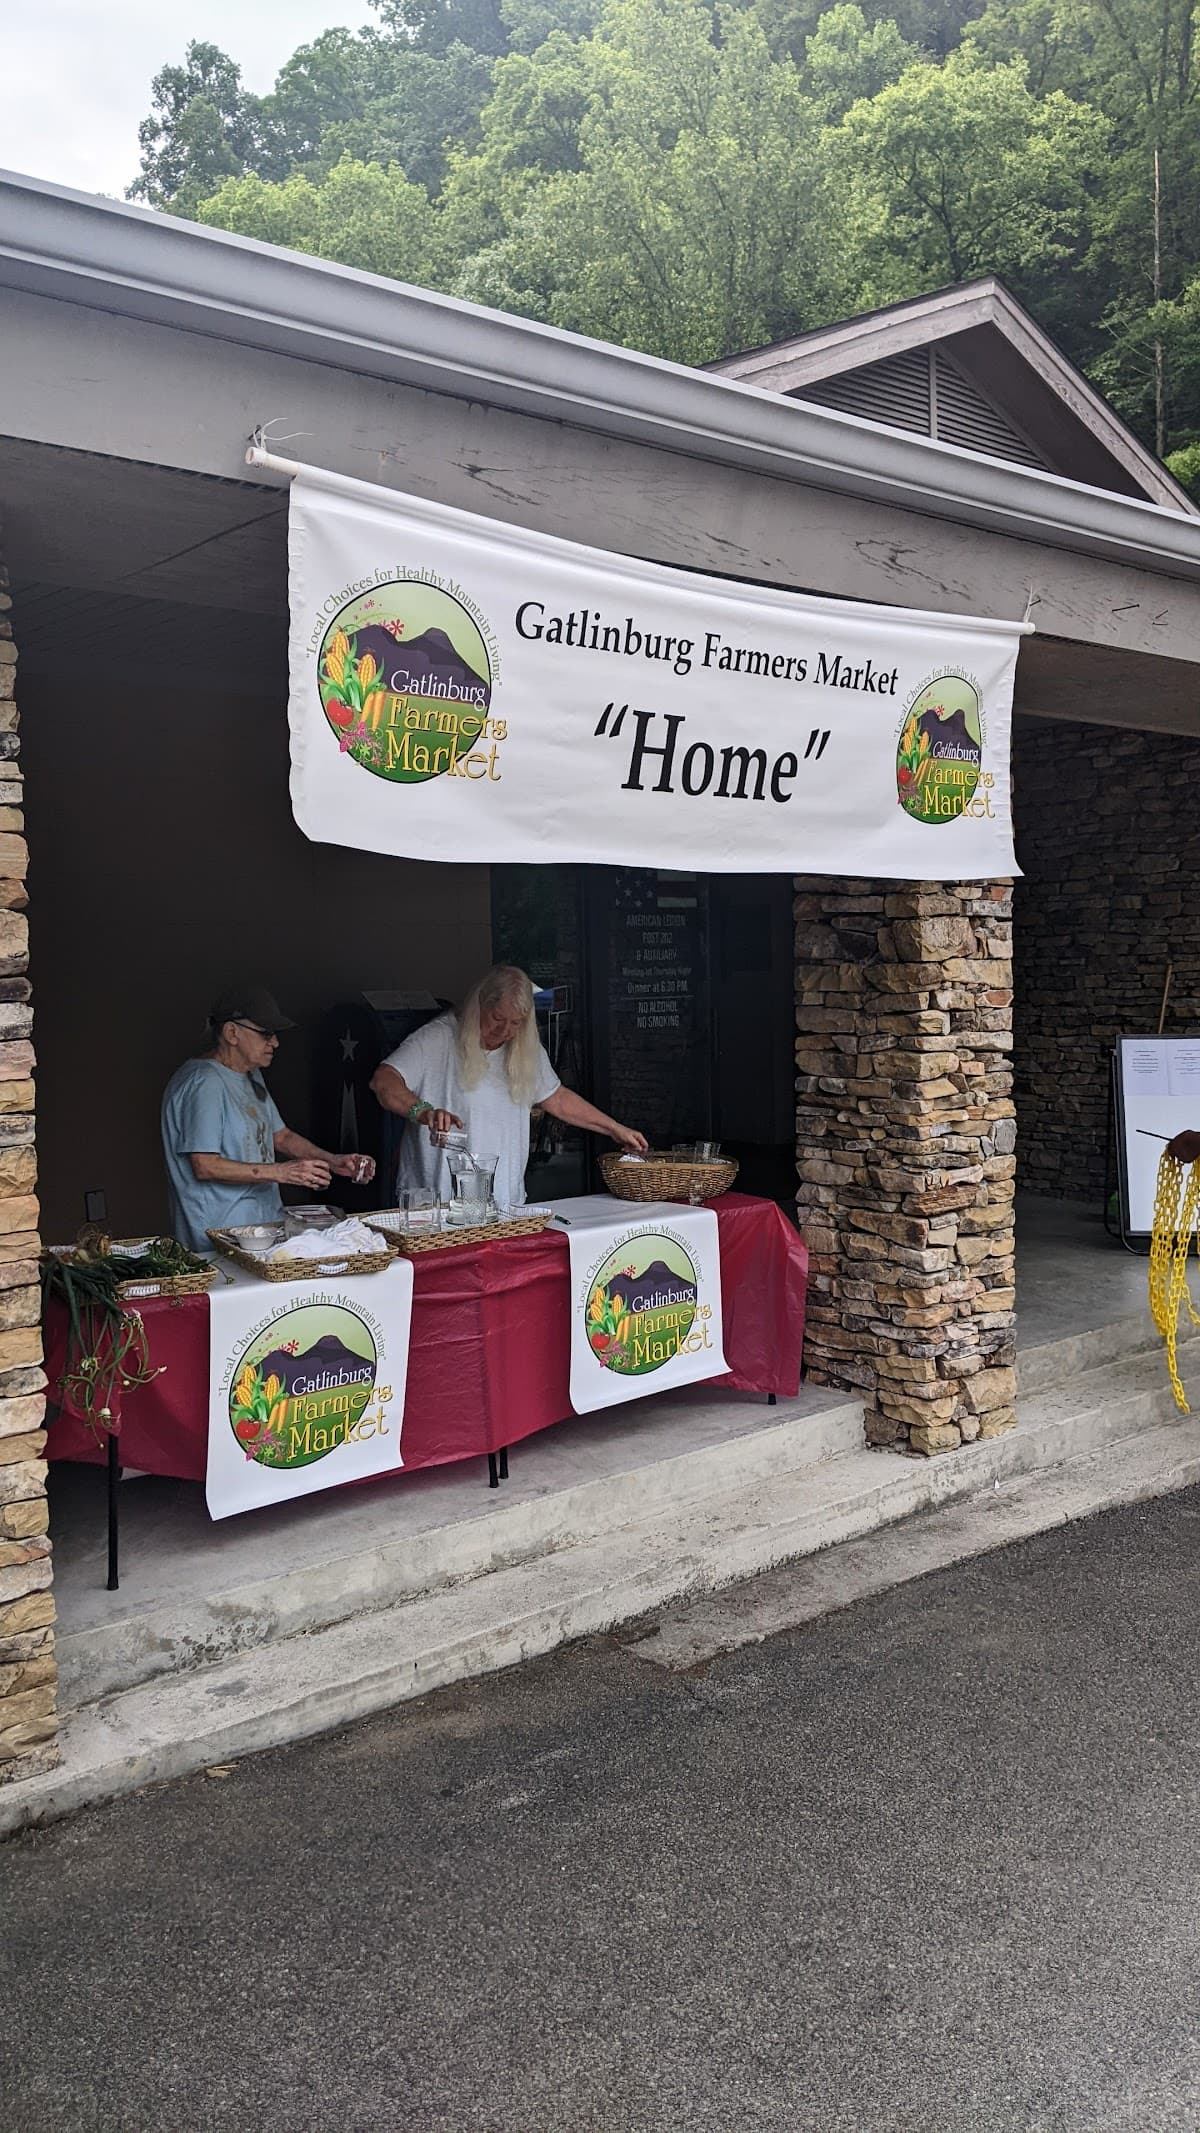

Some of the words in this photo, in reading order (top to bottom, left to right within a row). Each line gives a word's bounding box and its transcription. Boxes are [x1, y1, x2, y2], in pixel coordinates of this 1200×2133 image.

[323, 576, 373, 614] Choices
[374, 567, 392, 584] for
[396, 566, 444, 588] Healthy
[446, 580, 490, 636] Mountain
[515, 602, 694, 675] Gatlinburg
[701, 633, 807, 681] Farmers
[813, 653, 898, 695] Market
[391, 670, 486, 711] Gatlinburg
[906, 675, 931, 704] Choices
[933, 668, 942, 678] for
[388, 696, 507, 740] Farmers
[386, 730, 502, 780] Market
[594, 702, 831, 802] "Home"
[933, 741, 979, 767] Gatlinburg
[926, 761, 995, 788] Farmers
[924, 785, 996, 818] Market
[626, 914, 661, 927] AMERICAN
[642, 932, 658, 944] POST
[628, 982, 651, 994] Dinner
[652, 983, 660, 992] at
[677, 980, 688, 992] PM
[638, 1001, 648, 1014] NO
[650, 1000, 678, 1012] ALCOHOL
[638, 1016, 646, 1028] NO
[648, 1015, 680, 1028] SMOKING
[586, 1243, 614, 1280] Choices
[613, 1234, 625, 1248] for
[626, 1223, 659, 1240] Healthy
[659, 1225, 694, 1253] Mountain
[632, 1287, 695, 1312] Gatlinburg
[232, 1314, 271, 1356] Choices
[272, 1304, 288, 1318] for
[290, 1292, 334, 1310] Healthy
[335, 1293, 376, 1329] Mountain
[633, 1303, 712, 1338] Farmers
[632, 1322, 713, 1367] Market
[292, 1366, 372, 1395] Gatlinburg
[292, 1384, 393, 1425] Farmers
[289, 1406, 390, 1459] Market
